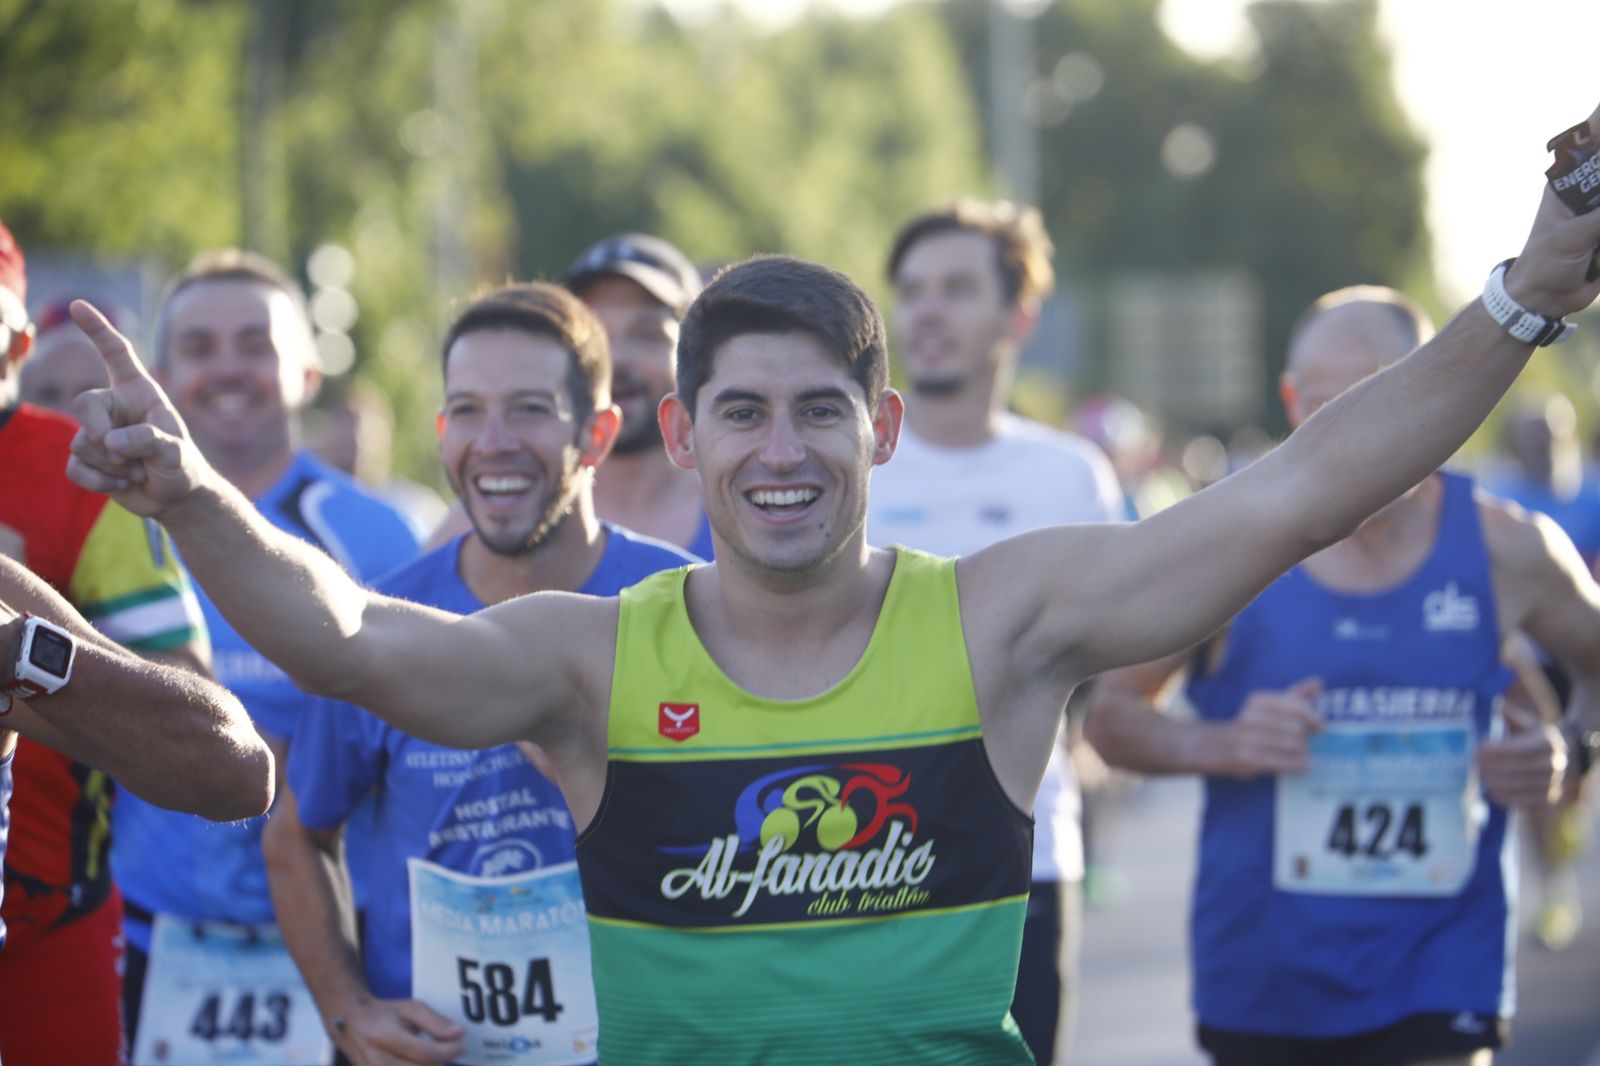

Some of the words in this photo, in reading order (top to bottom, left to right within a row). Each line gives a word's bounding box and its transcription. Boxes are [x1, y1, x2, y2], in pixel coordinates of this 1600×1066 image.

[453, 787, 537, 821] HOSTAL
[1327, 804, 1429, 858] 424
[807, 888, 850, 915] club
[457, 956, 564, 1027] 584
[190, 994, 291, 1043] 443
